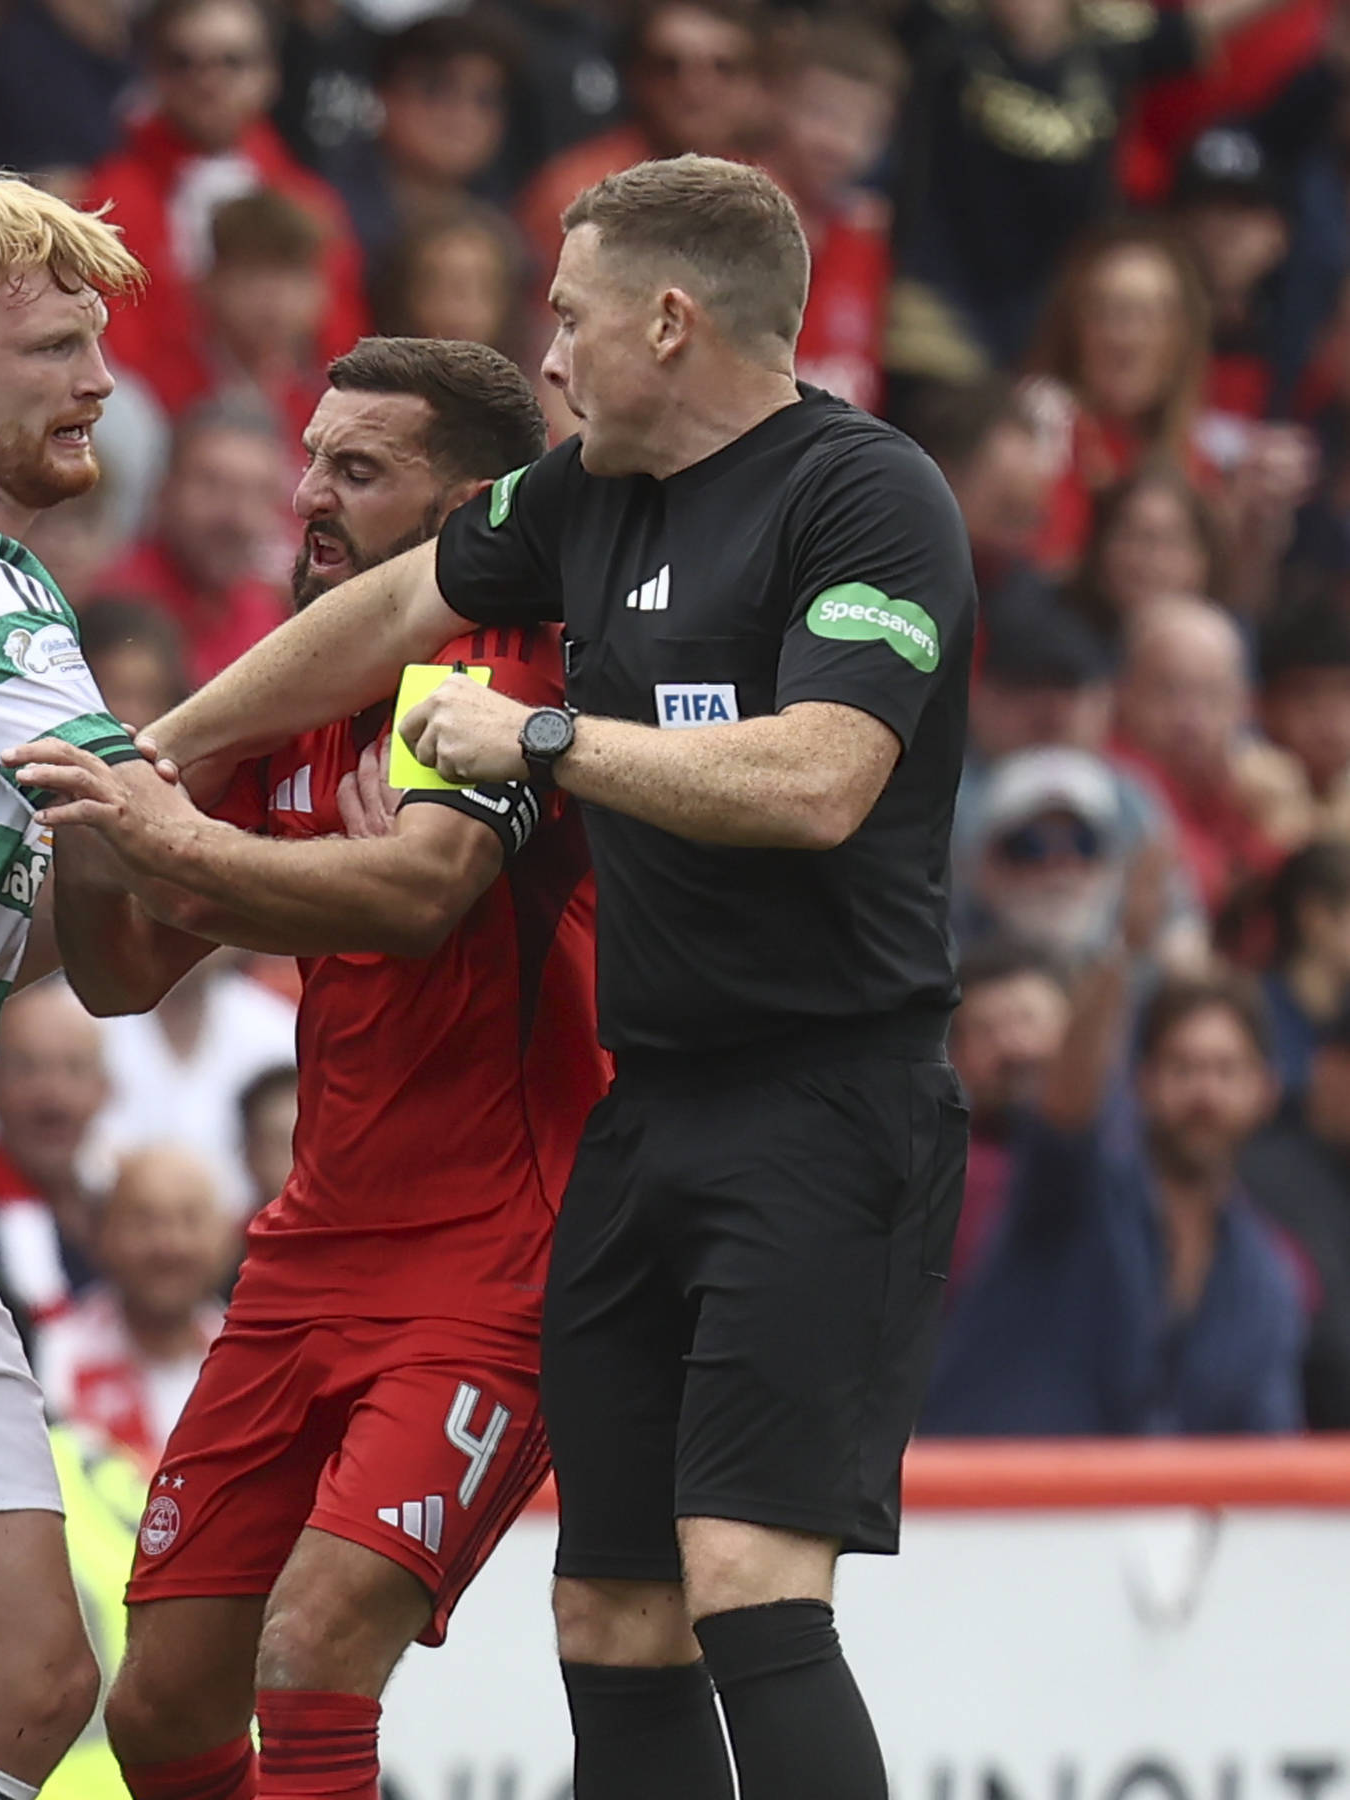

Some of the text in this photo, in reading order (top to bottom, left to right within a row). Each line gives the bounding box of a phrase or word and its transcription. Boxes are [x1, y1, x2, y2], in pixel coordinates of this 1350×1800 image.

[818, 599, 935, 657] Specsavers
[663, 694, 730, 721] FIFA
[444, 1379, 513, 1511] 4
